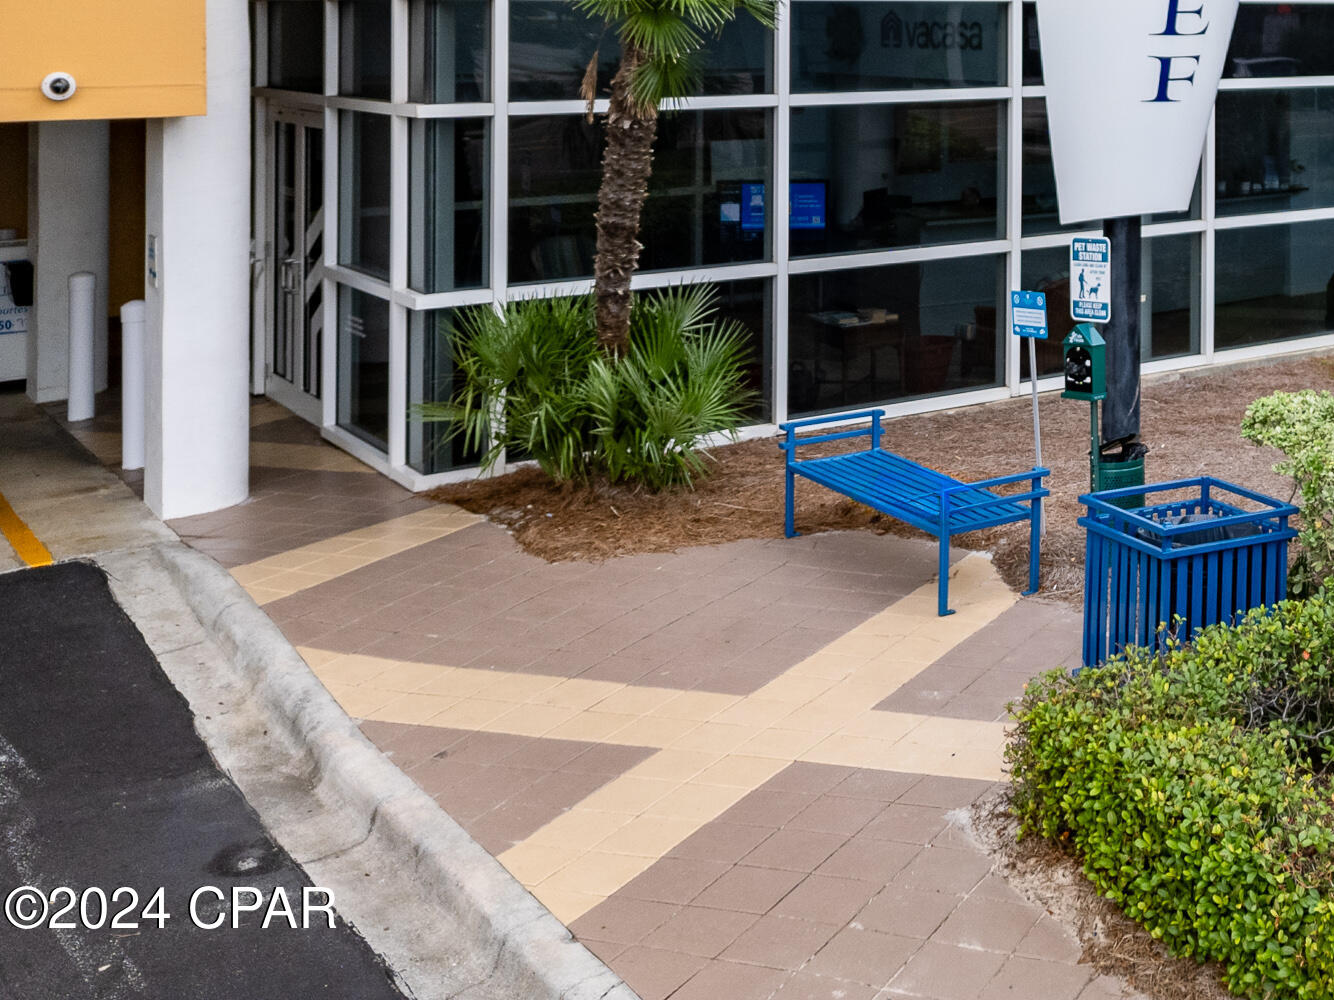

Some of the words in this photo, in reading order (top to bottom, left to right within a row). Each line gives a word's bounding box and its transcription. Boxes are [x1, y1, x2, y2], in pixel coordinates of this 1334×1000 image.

[904, 19, 983, 51] vacasa
[1074, 242, 1085, 251] PET
[1086, 243, 1107, 253] WASTE
[1078, 251, 1103, 261] STATION
